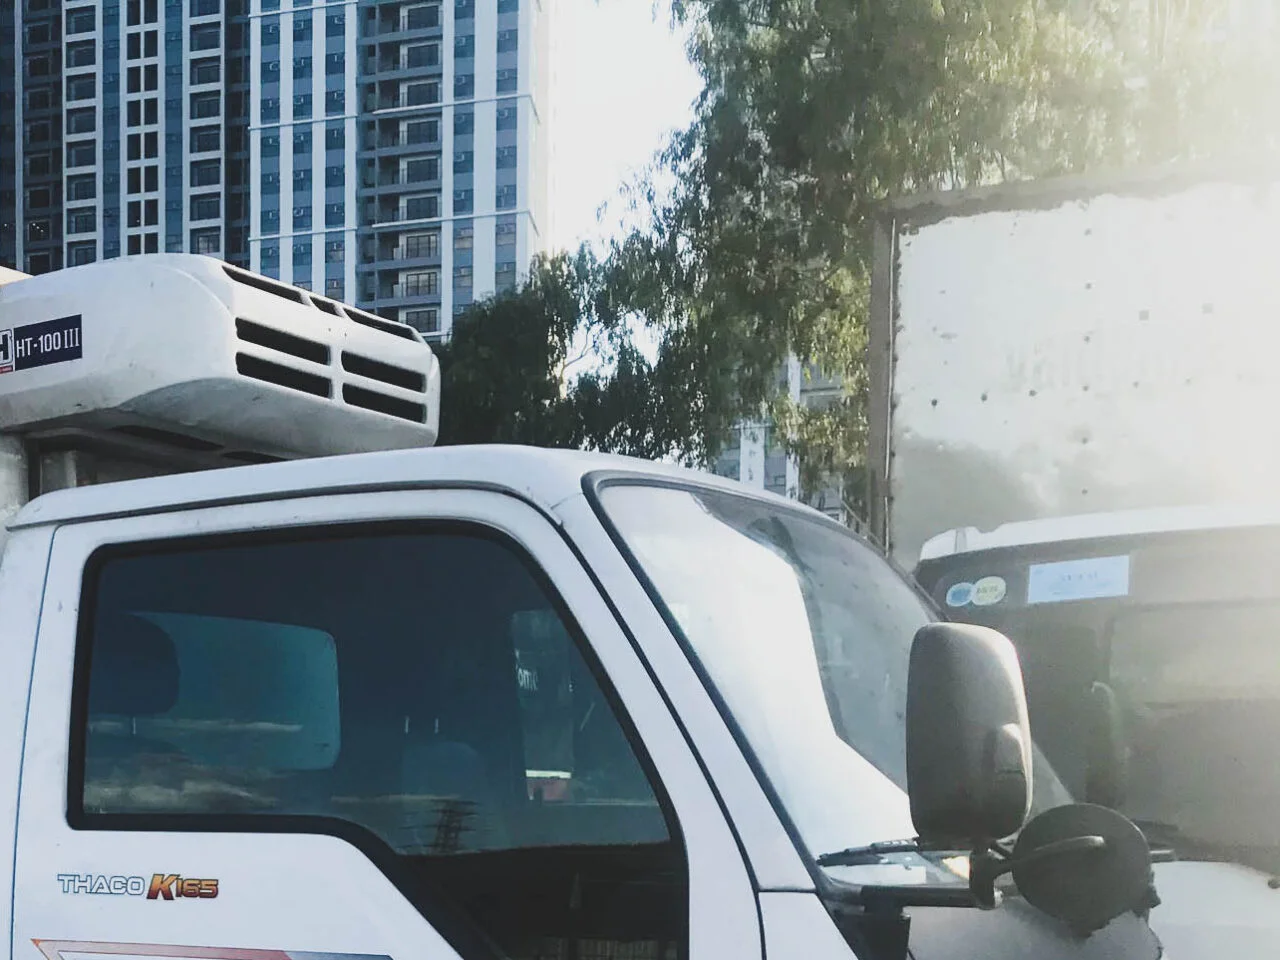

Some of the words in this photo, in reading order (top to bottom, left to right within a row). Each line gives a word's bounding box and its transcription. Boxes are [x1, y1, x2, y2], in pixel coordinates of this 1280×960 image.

[16, 331, 61, 358] HT-100
[64, 327, 80, 349] III
[57, 873, 145, 895] THACO
